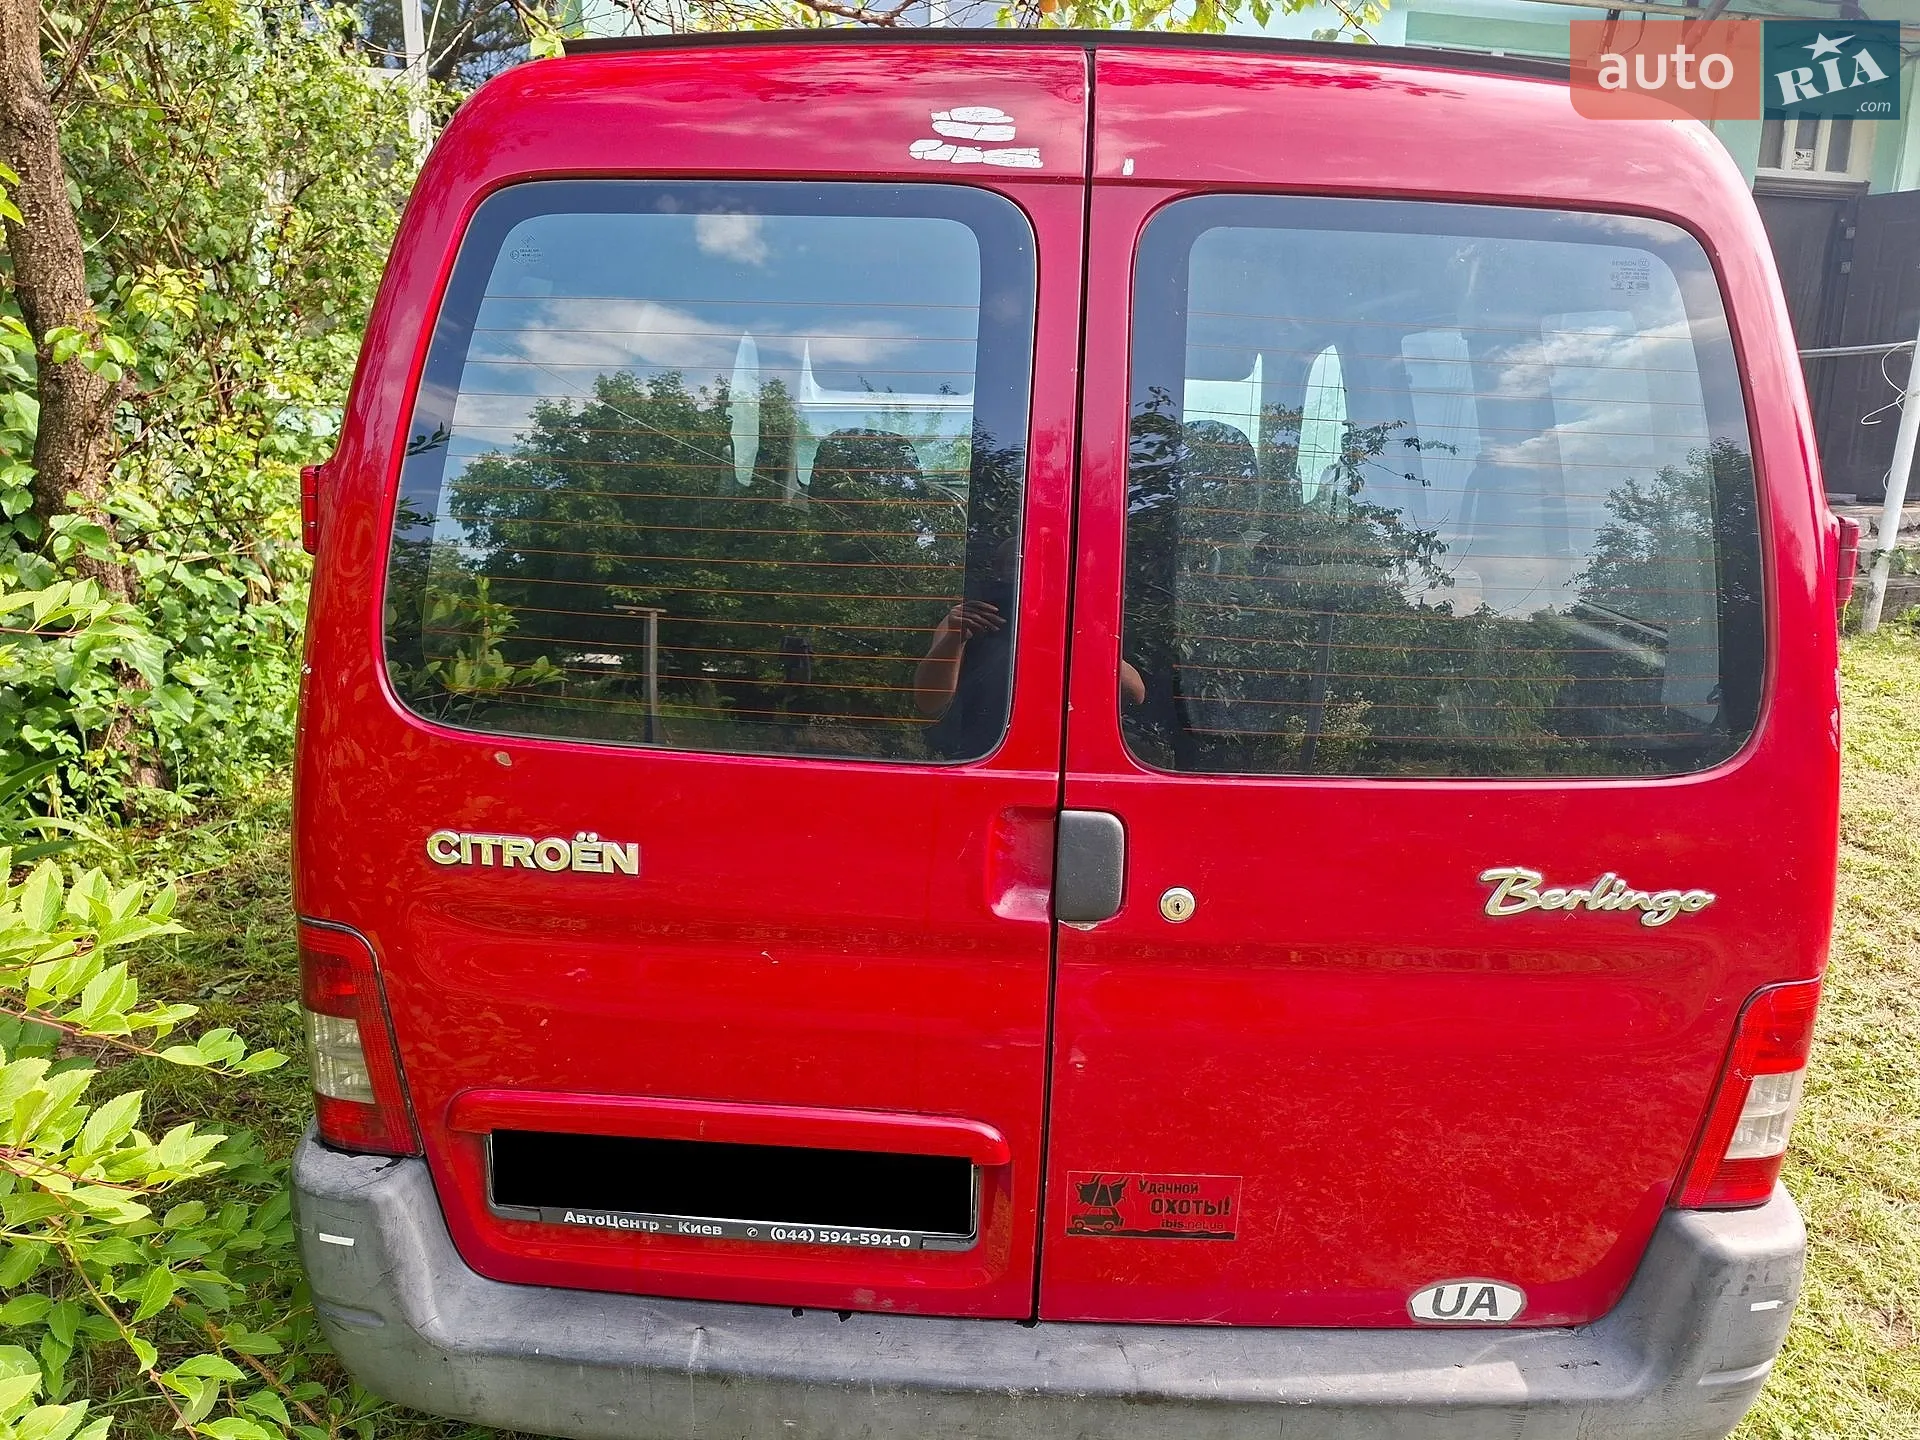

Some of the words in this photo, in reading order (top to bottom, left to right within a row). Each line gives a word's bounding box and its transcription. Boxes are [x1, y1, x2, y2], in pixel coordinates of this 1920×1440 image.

[426, 830, 639, 875] CITROËN
[1479, 866, 1716, 927] Berlingo
[1138, 1180, 1199, 1195] Удачной
[563, 1211, 660, 1232] АвтоЦентр
[678, 1221, 722, 1236] Киев
[770, 1226, 815, 1243] (044)
[819, 1230, 911, 1248] 594-594-0
[1432, 1286, 1499, 1317] UA
